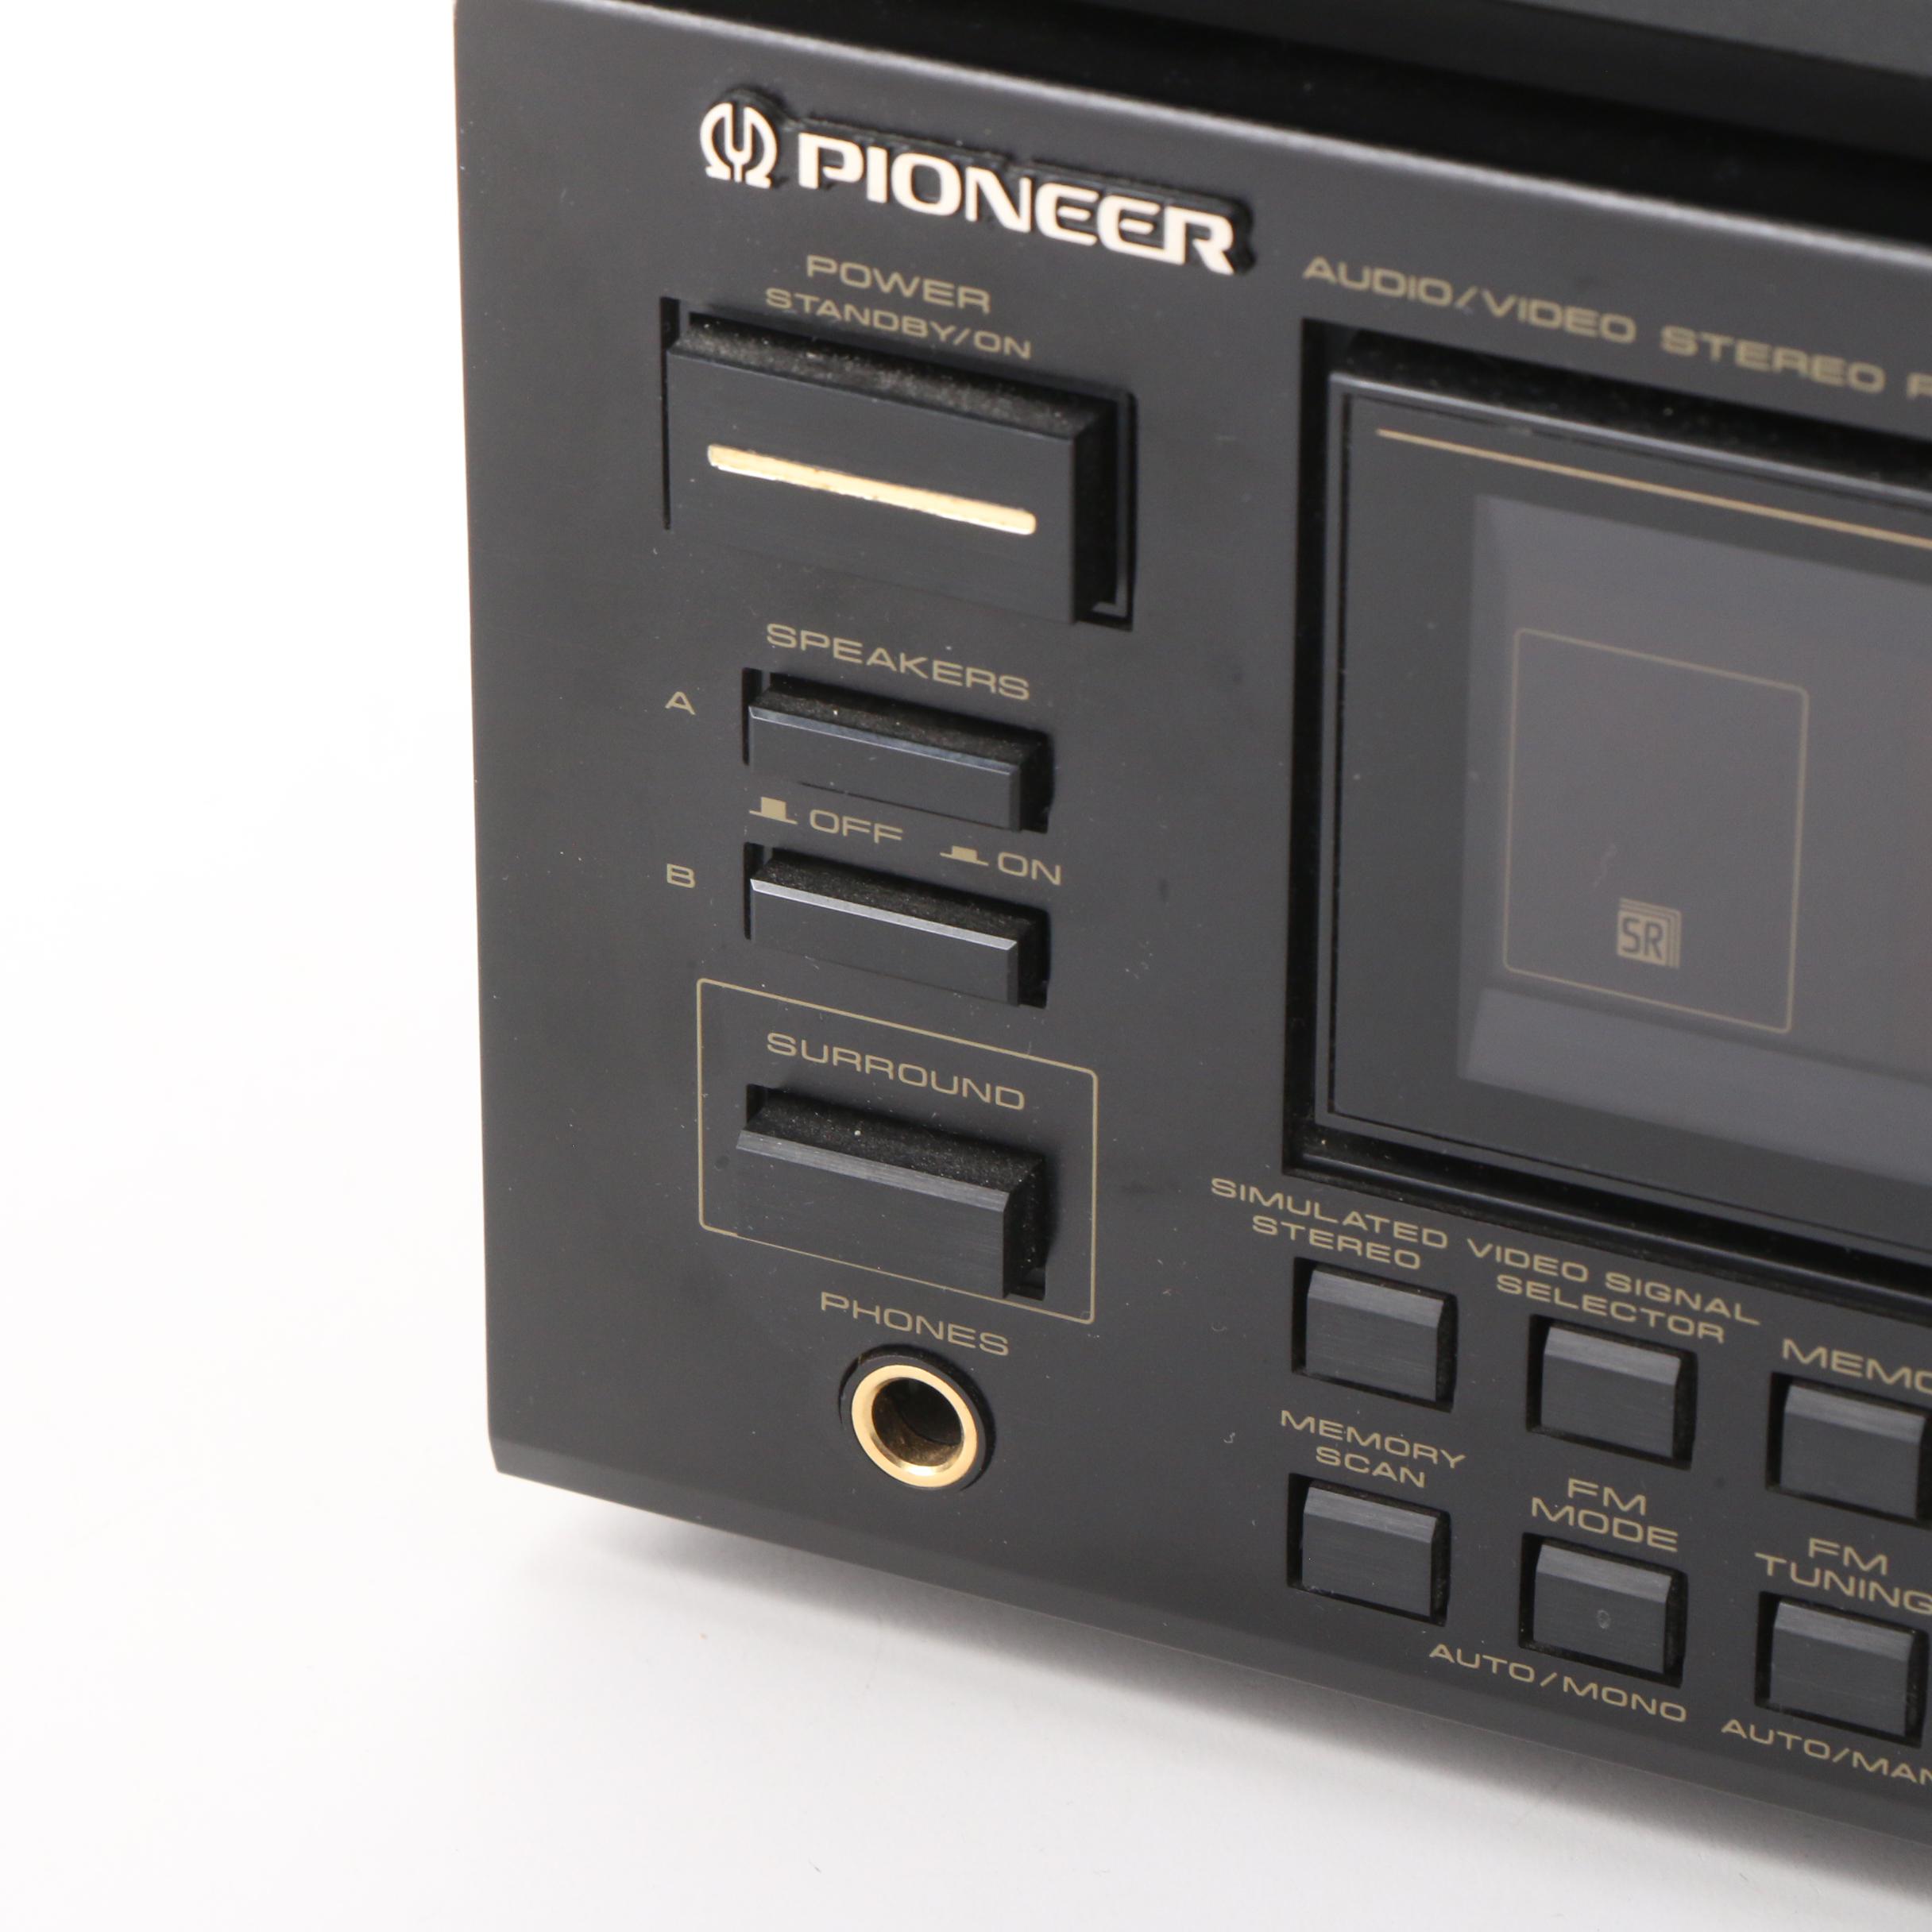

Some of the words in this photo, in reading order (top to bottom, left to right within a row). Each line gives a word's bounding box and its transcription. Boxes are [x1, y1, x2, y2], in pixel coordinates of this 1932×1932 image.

[798, 131, 1235, 275] PIONEER
[807, 253, 992, 314] POWER
[767, 287, 1033, 360] STANDBY/ON
[1304, 255, 1637, 343] AUDIO/VIDEO
[1661, 325, 1887, 392] STEREO
[767, 622, 1031, 701] SPEAKERS
[667, 690, 696, 715] A
[667, 864, 697, 888] B
[810, 809, 903, 842] OFF
[998, 852, 1064, 885] ON
[1621, 914, 1667, 961] SR
[767, 1031, 1027, 1111] SURROUND
[1211, 1177, 1449, 1248] SIMULATED
[1254, 1213, 1423, 1269] STEREO
[1469, 1238, 1590, 1283] VIDEO
[1605, 1271, 1760, 1325] SIGNAL
[1497, 1273, 1725, 1343] SELECTOR
[821, 1290, 1010, 1355] PHONES
[1281, 1410, 1466, 1470] MEMORY
[1317, 1444, 1427, 1487] SCAN
[1531, 1496, 1678, 1551] MODE
[1568, 1475, 1648, 1514] FM
[1756, 1551, 1932, 1614] TUNING
[1809, 1537, 1890, 1575] FM
[1431, 1643, 1688, 1721] AUTO/MONO
